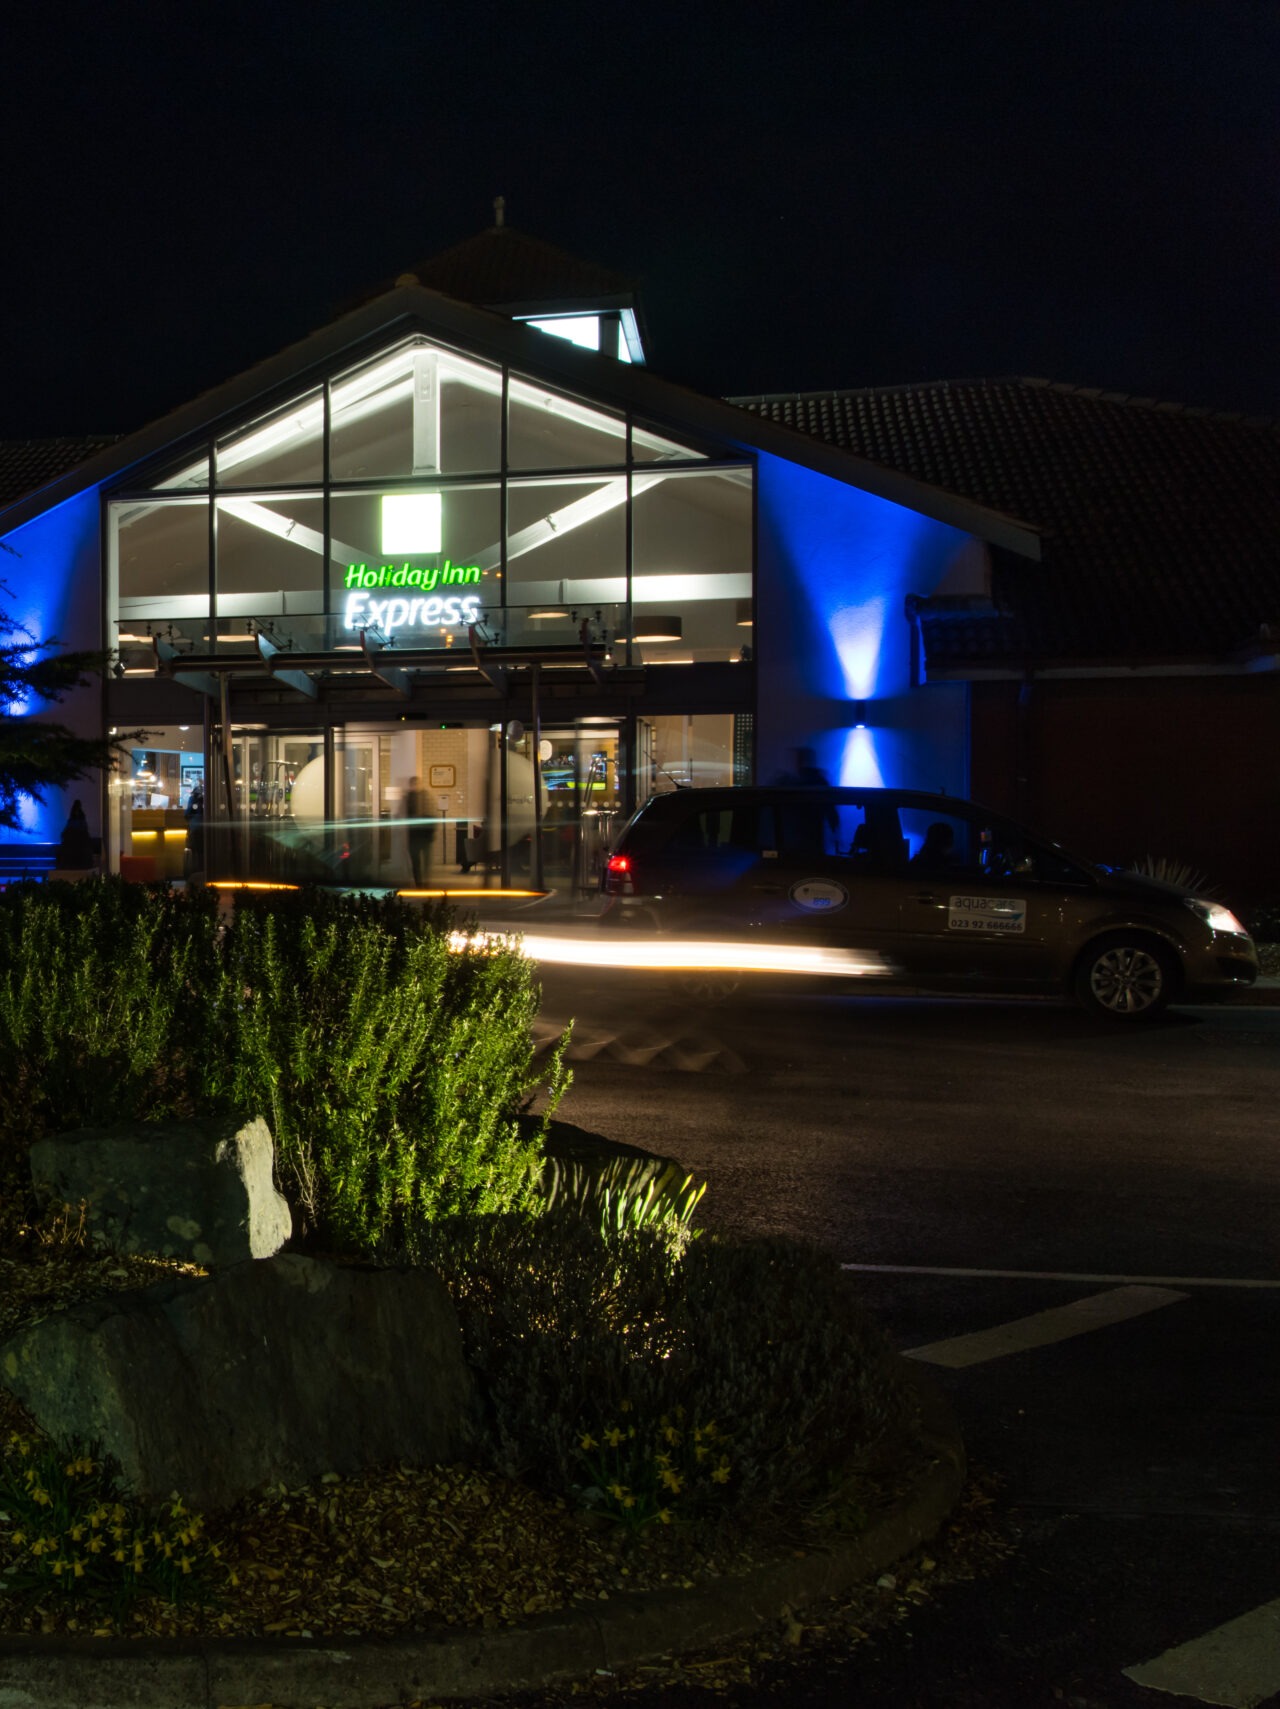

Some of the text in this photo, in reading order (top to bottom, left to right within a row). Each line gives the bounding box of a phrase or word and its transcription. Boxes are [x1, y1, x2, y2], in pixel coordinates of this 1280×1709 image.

[345, 560, 481, 591] Holiday Inn
[345, 591, 481, 636] Express
[951, 919, 969, 928] 023
[972, 920, 984, 929] 92
